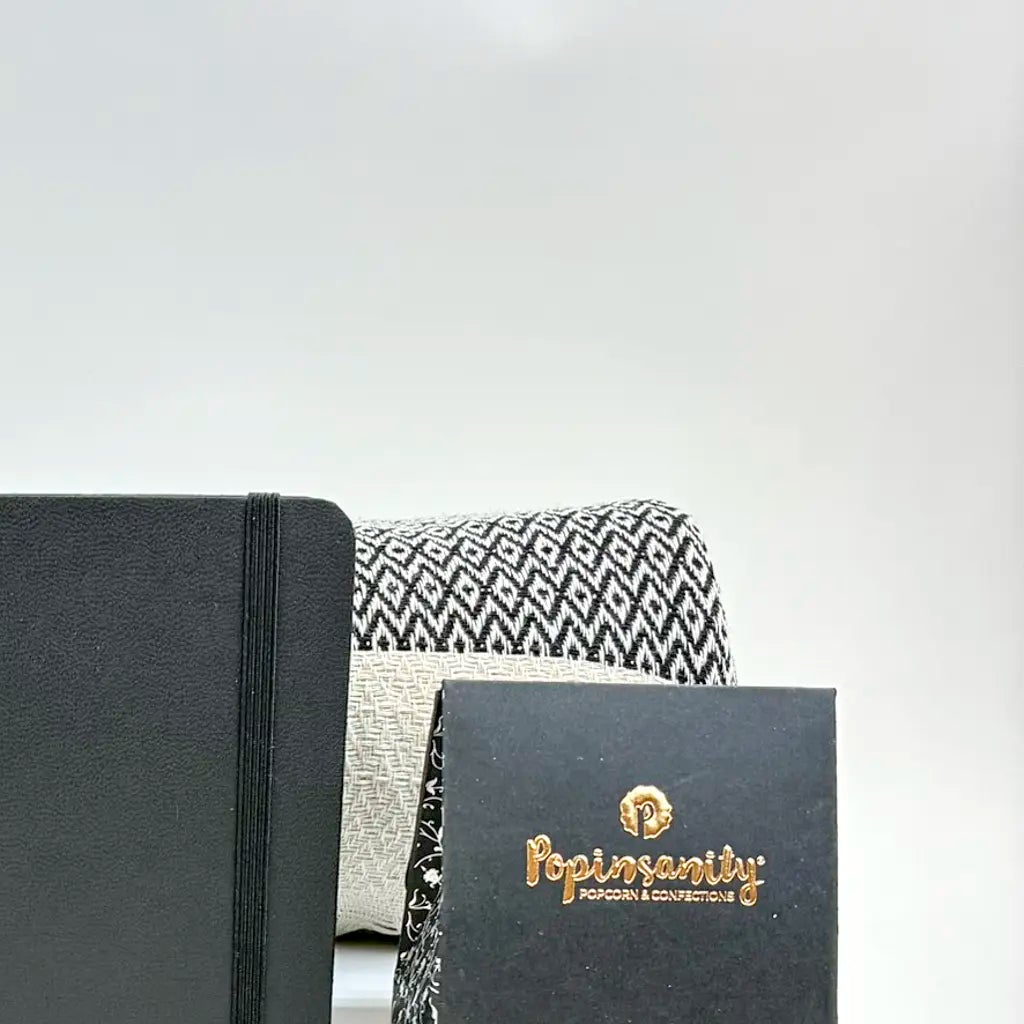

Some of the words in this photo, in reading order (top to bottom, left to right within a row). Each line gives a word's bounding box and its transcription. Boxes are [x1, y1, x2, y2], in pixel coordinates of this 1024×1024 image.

[526, 833, 764, 907] Popinsanity
[579, 888, 639, 900] POPCORN
[641, 888, 650, 901] &
[651, 889, 735, 902] CONFECTIONS
